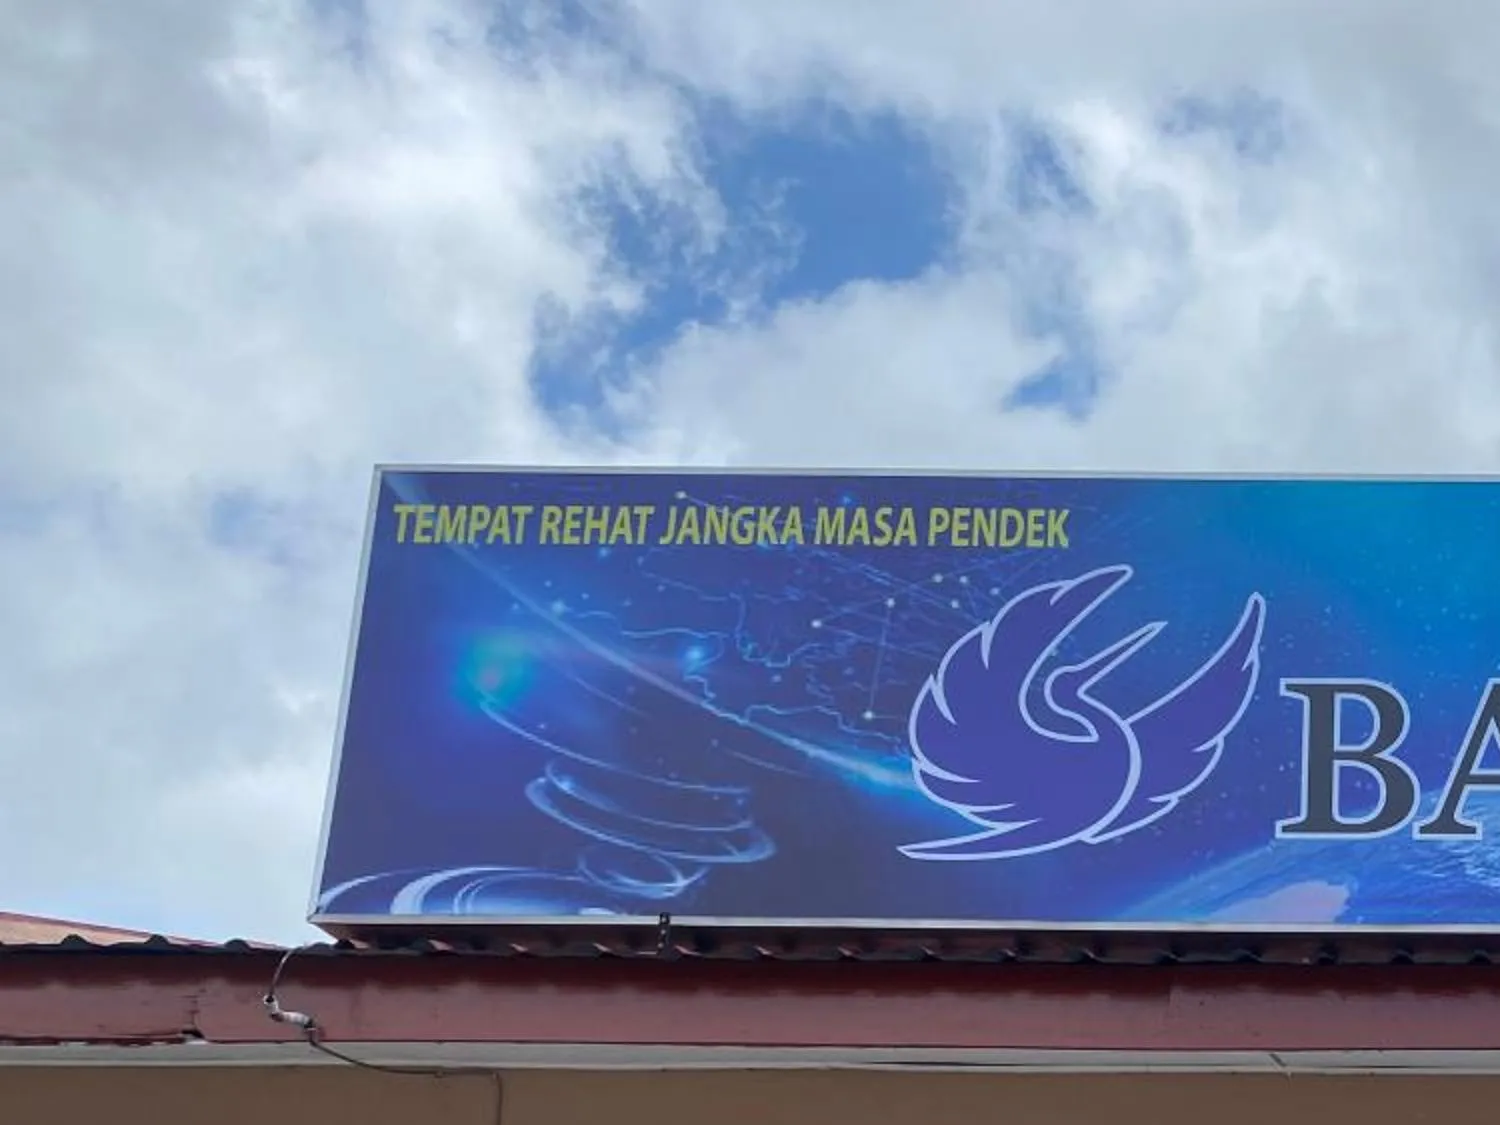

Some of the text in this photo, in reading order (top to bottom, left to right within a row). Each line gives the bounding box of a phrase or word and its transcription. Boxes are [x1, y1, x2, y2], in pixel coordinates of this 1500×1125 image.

[393, 503, 1071, 549] TEMPAT REHAT JANGKA MASA PENDEK
